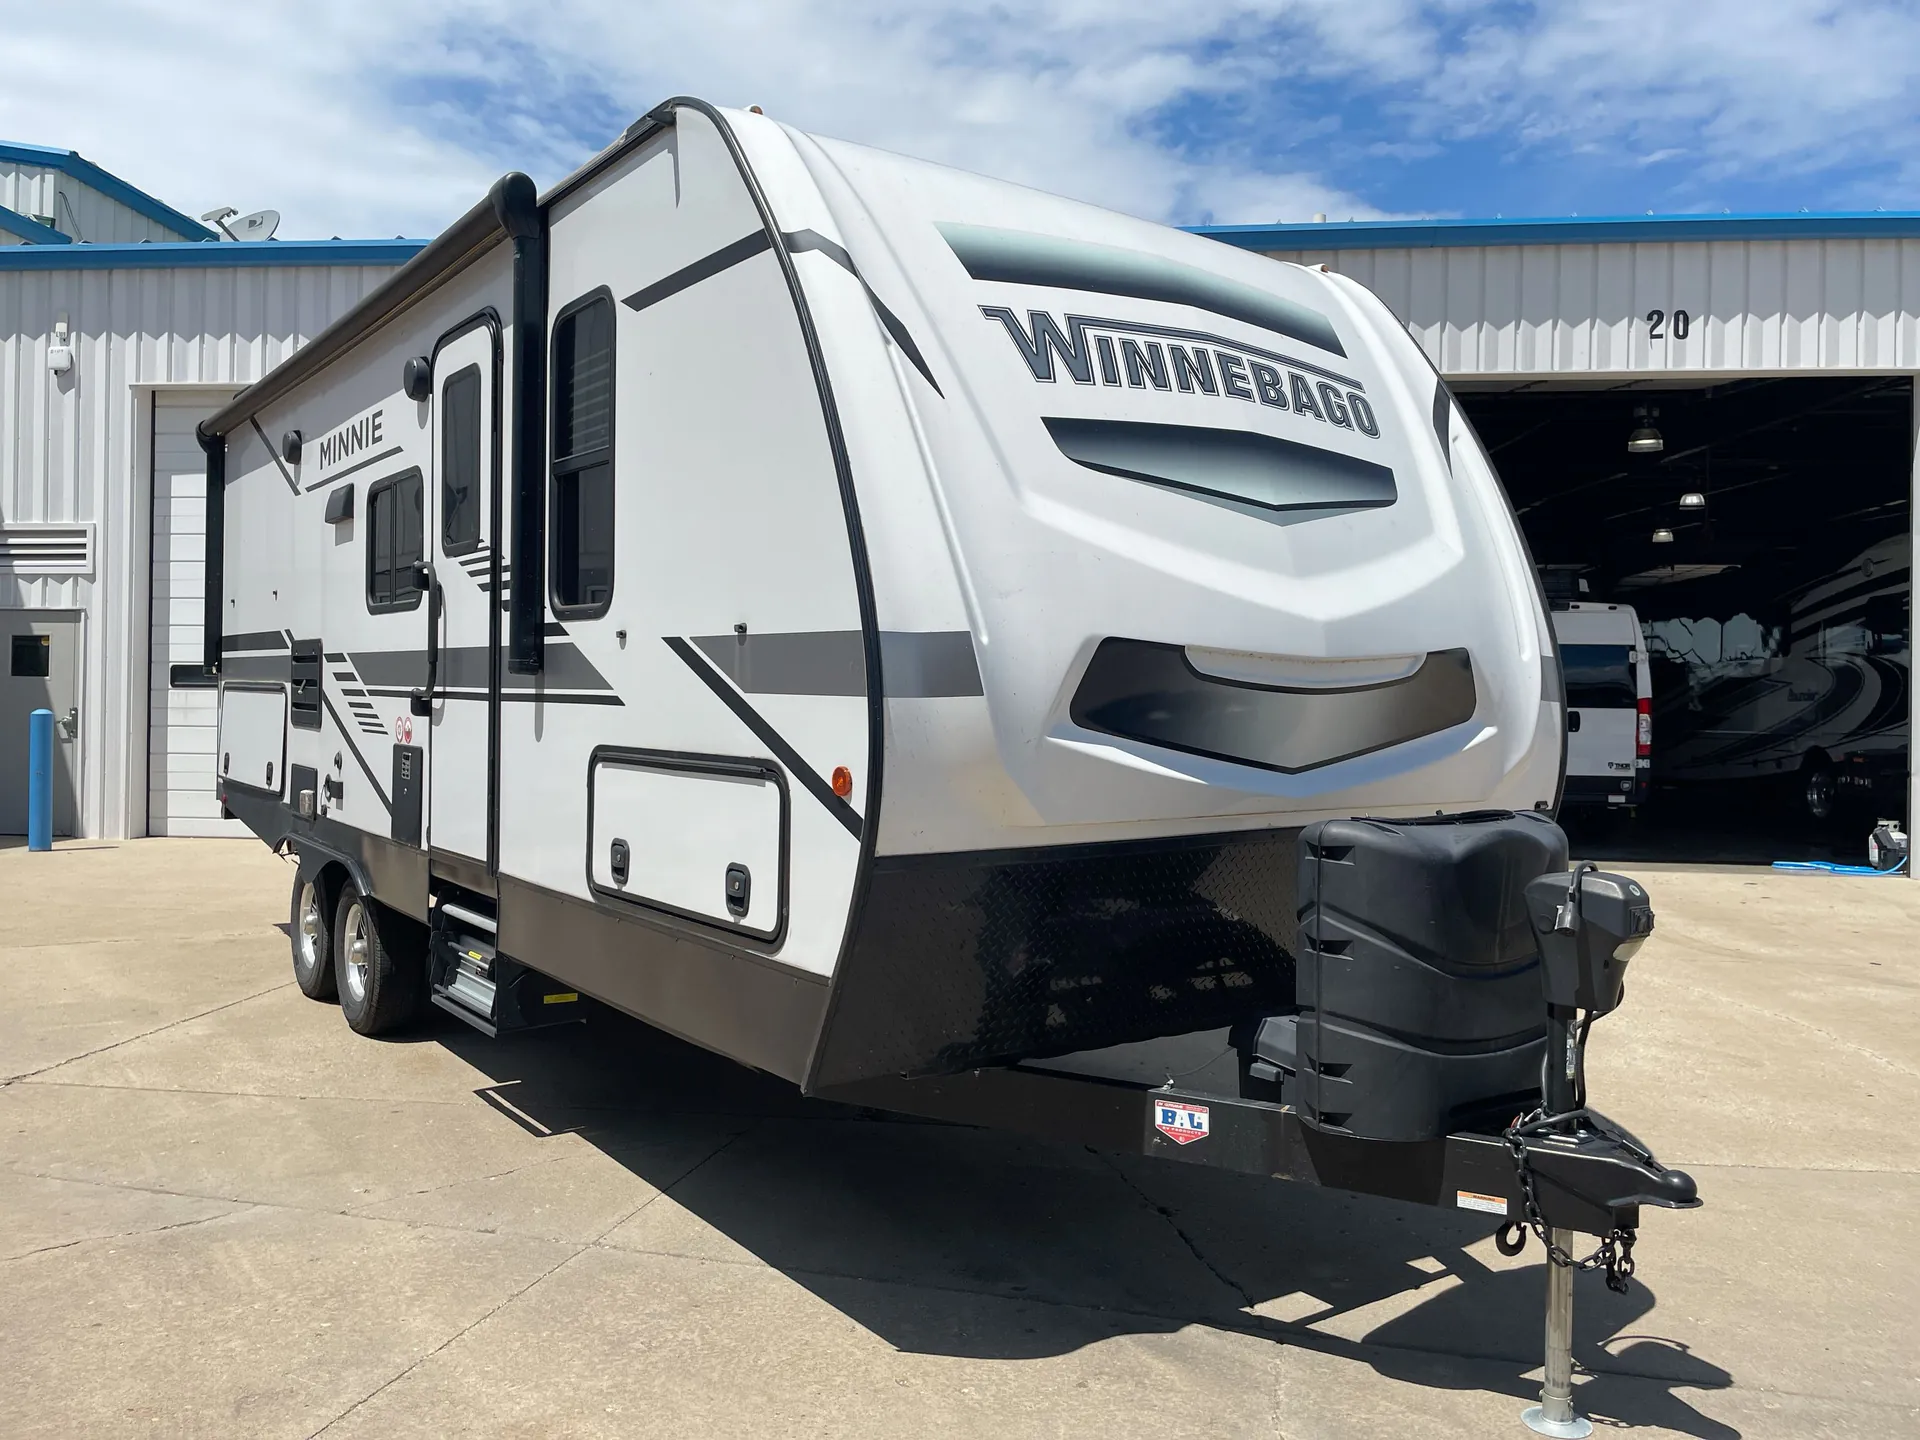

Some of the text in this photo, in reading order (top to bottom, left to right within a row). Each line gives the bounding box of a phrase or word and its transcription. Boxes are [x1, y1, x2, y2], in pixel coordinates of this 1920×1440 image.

[1646, 309, 1689, 340] 20
[979, 305, 1380, 439] WINNEBAGO
[320, 409, 383, 470] MINNIE
